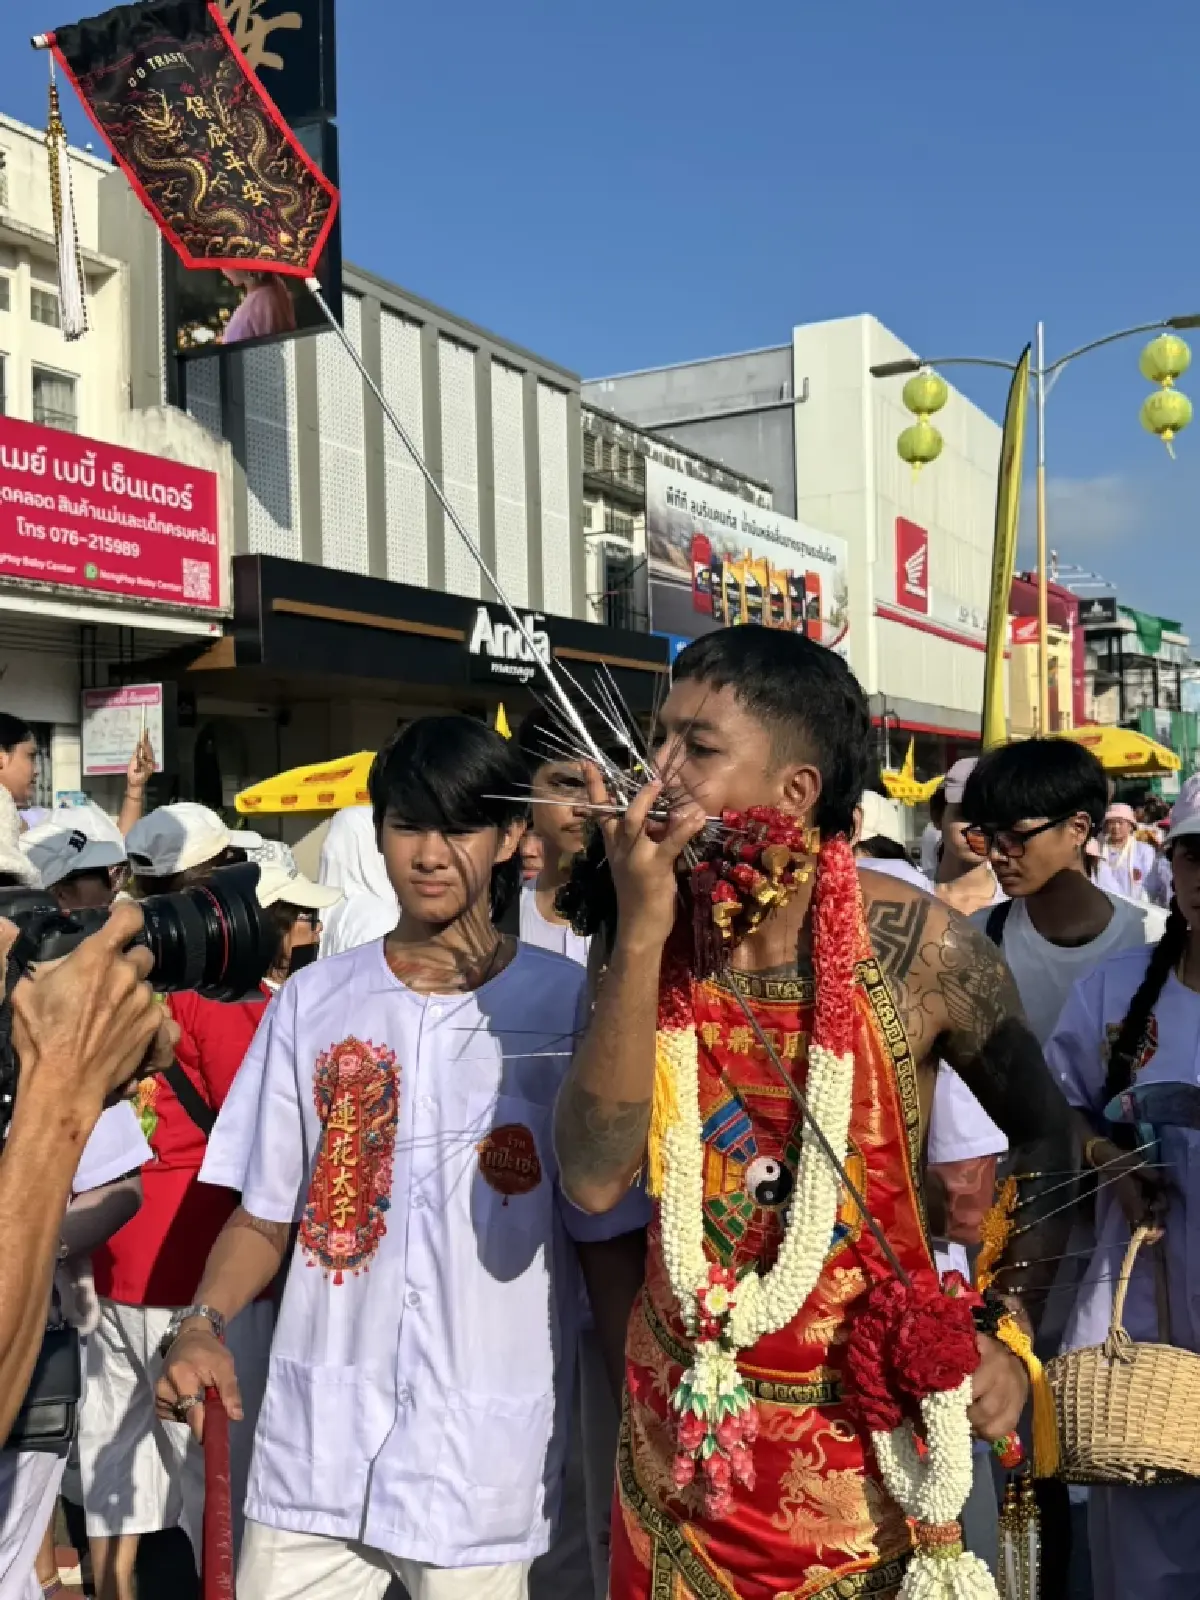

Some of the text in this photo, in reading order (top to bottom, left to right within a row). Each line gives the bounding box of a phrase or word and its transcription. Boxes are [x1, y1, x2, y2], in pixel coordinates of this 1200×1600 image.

[102, 462, 194, 511] เซ็นเตอร์
[16, 516, 46, 539] โทร
[328, 1092, 360, 1229] 蓮花太子
